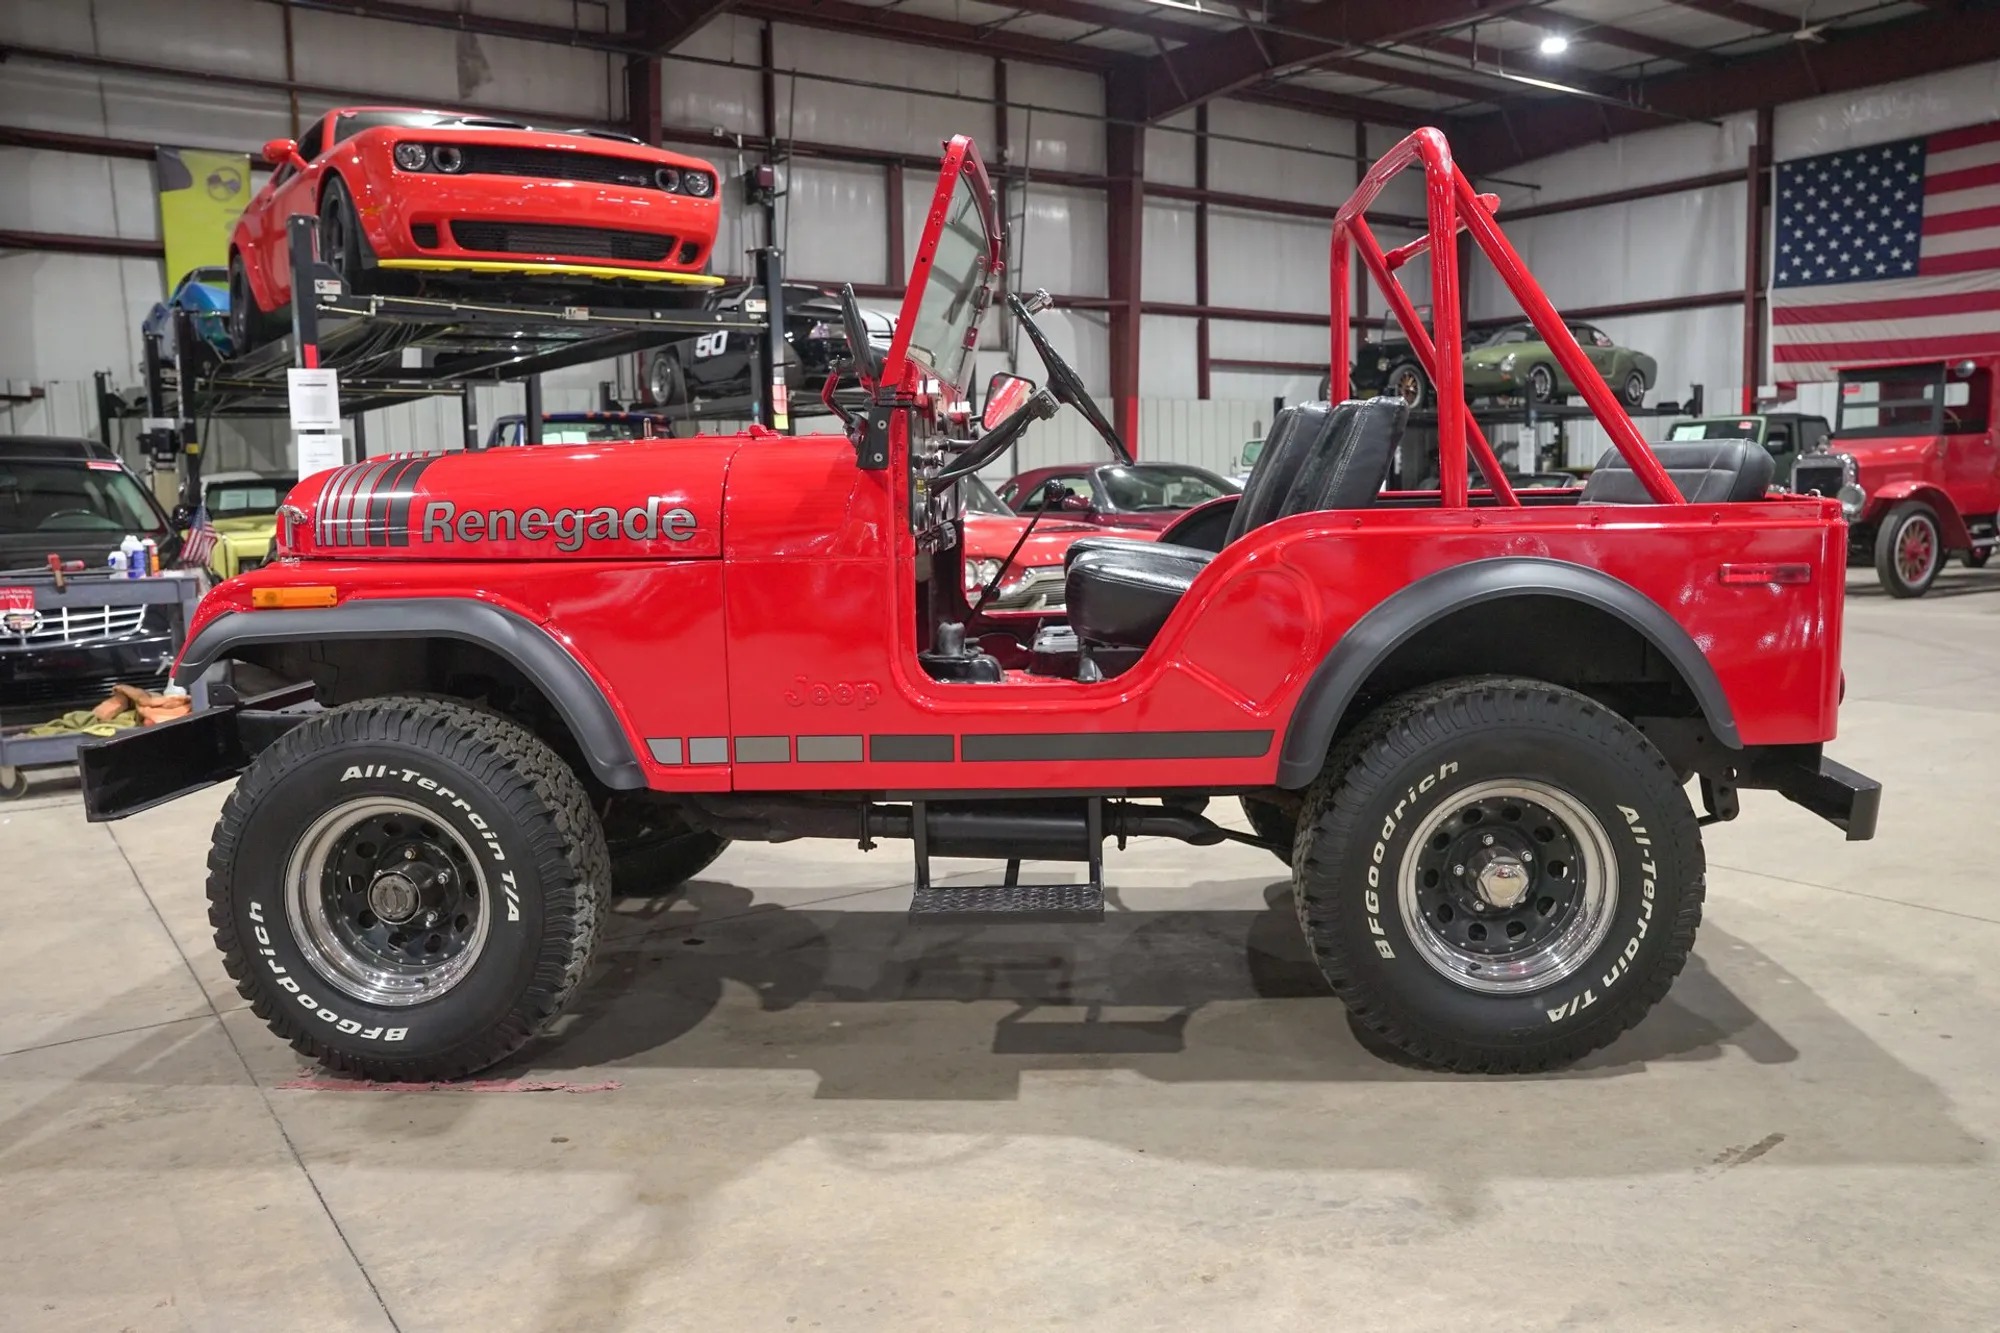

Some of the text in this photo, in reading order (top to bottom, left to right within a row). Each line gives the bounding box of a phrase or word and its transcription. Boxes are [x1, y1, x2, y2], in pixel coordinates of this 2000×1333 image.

[695, 330, 729, 358] 50
[422, 496, 698, 552] Renegade
[784, 675, 881, 711] Jeep
[340, 764, 520, 921] All-Terrain T/A
[1366, 759, 1460, 960] BFGoodrich
[1547, 804, 1657, 1023] All-Terrain T/A
[248, 900, 409, 1042] BFGoodrich
